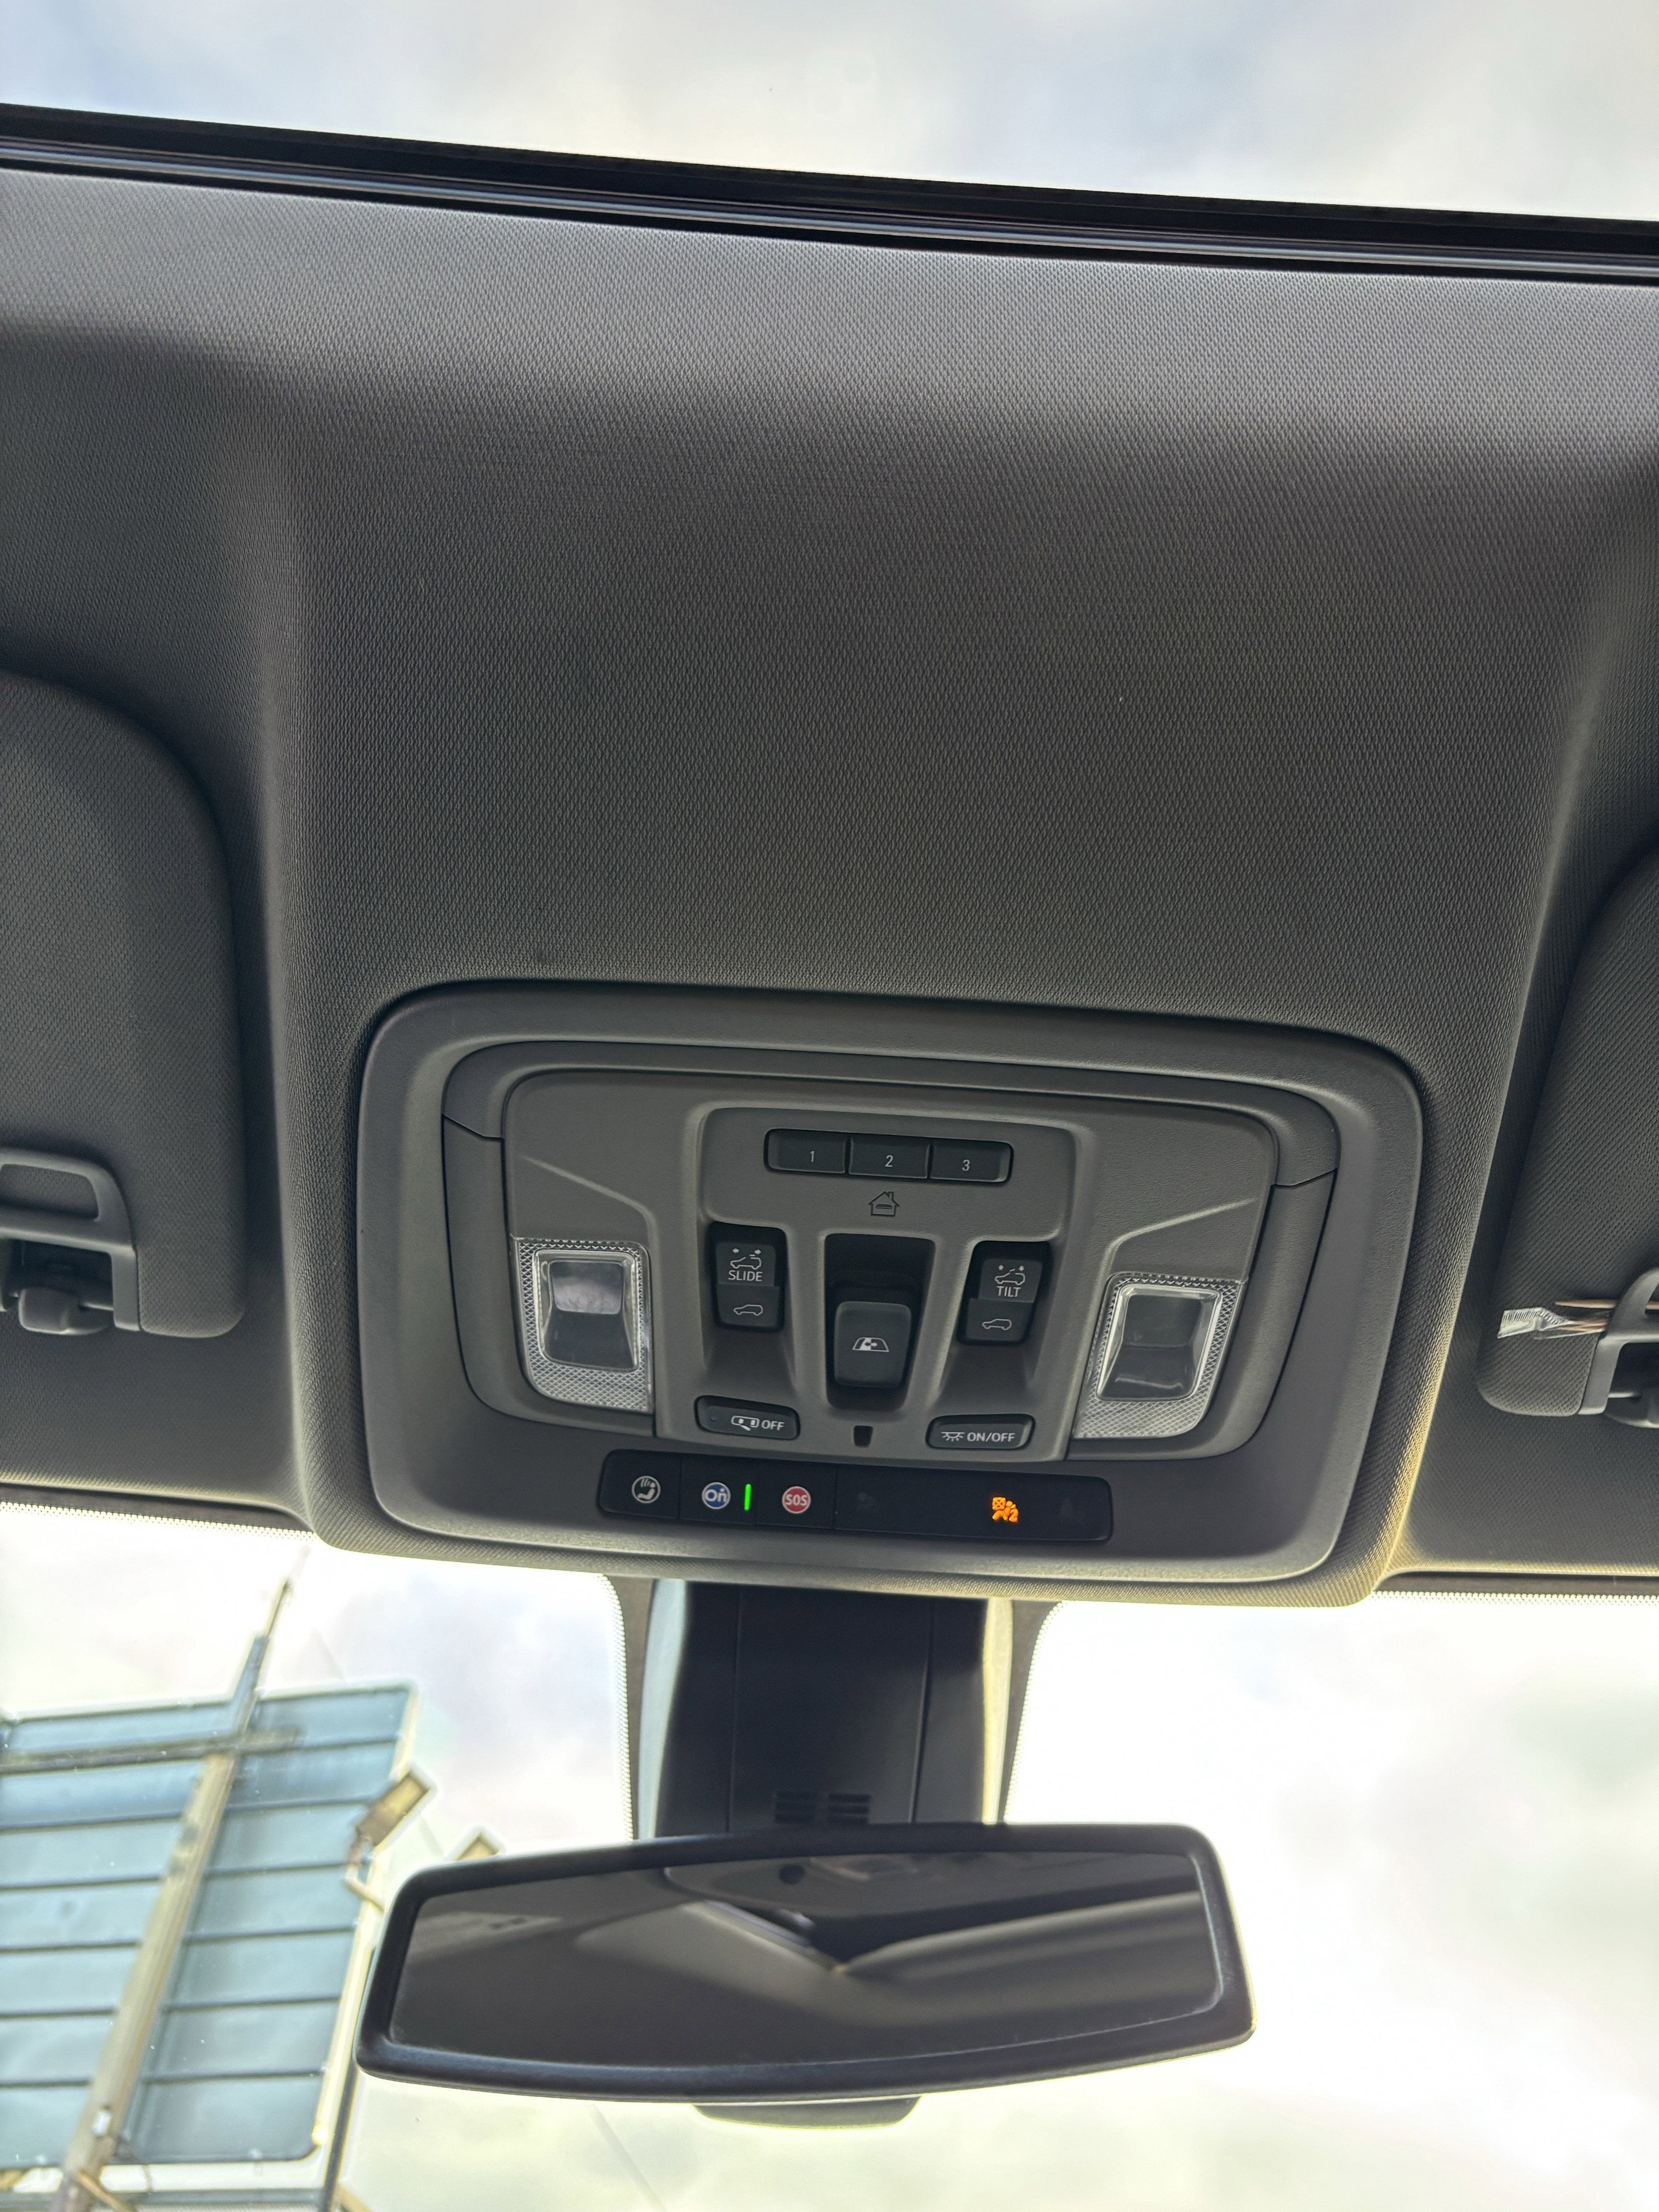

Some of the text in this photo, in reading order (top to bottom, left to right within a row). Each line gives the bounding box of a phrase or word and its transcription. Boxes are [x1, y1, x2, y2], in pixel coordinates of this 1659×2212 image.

[810, 1151, 815, 1162] 1
[885, 1155, 894, 1167] 2
[962, 1159, 970, 1172] 3
[728, 1270, 763, 1282] SLIDE
[996, 1286, 1022, 1298] TILT
[761, 1419, 785, 1431] OFF
[967, 1432, 1016, 1442] ON/OFF
[785, 1494, 807, 1506] SOS
